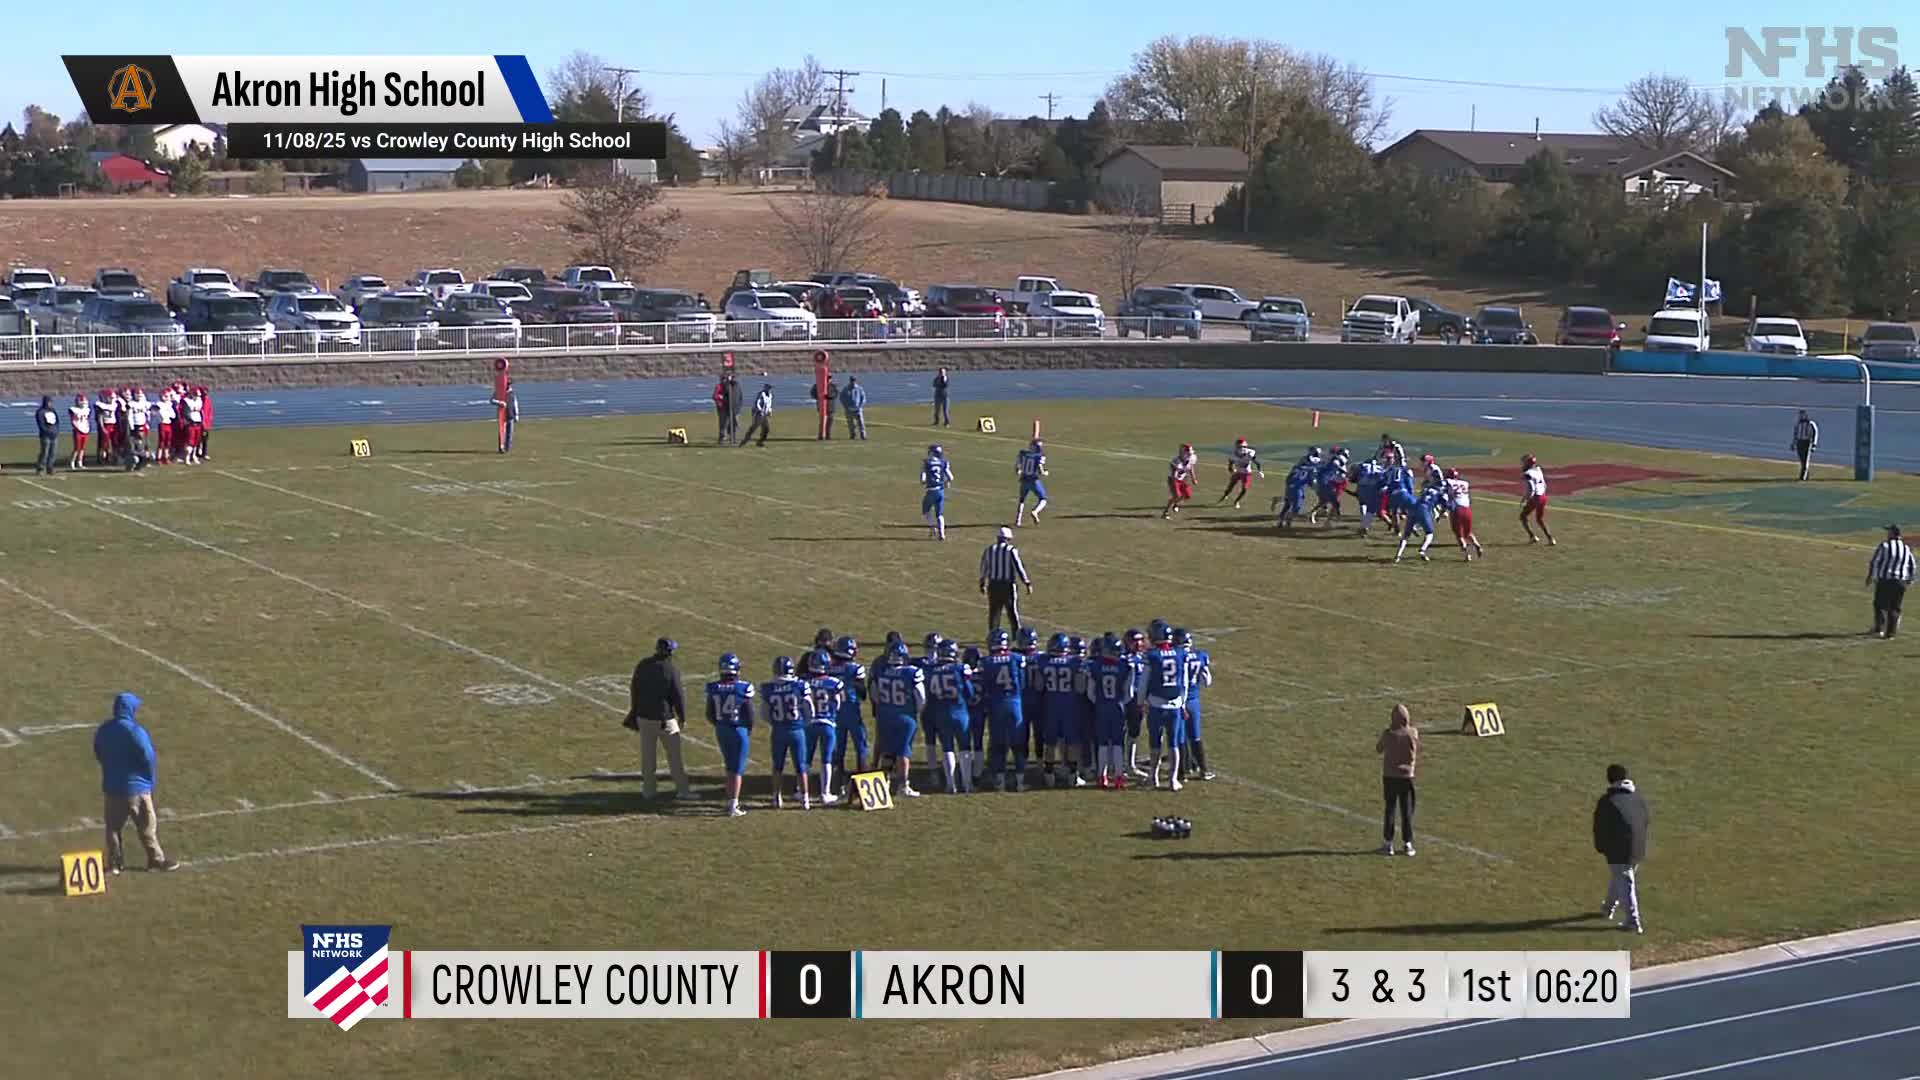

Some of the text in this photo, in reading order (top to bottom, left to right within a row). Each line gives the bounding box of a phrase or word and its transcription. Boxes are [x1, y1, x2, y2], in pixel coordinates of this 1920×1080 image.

[983, 420, 994, 431] G
[355, 443, 370, 456] 20
[996, 667, 1013, 691] 4
[1044, 667, 1072, 692] 32
[1162, 659, 1177, 687] 2
[878, 678, 905, 706] 56
[929, 674, 957, 700] 45
[1102, 675, 1117, 699] 8
[713, 694, 739, 721] 14
[769, 694, 800, 721] 33
[1475, 708, 1500, 734] 20
[860, 777, 887, 808] 30
[69, 856, 99, 892] 40
